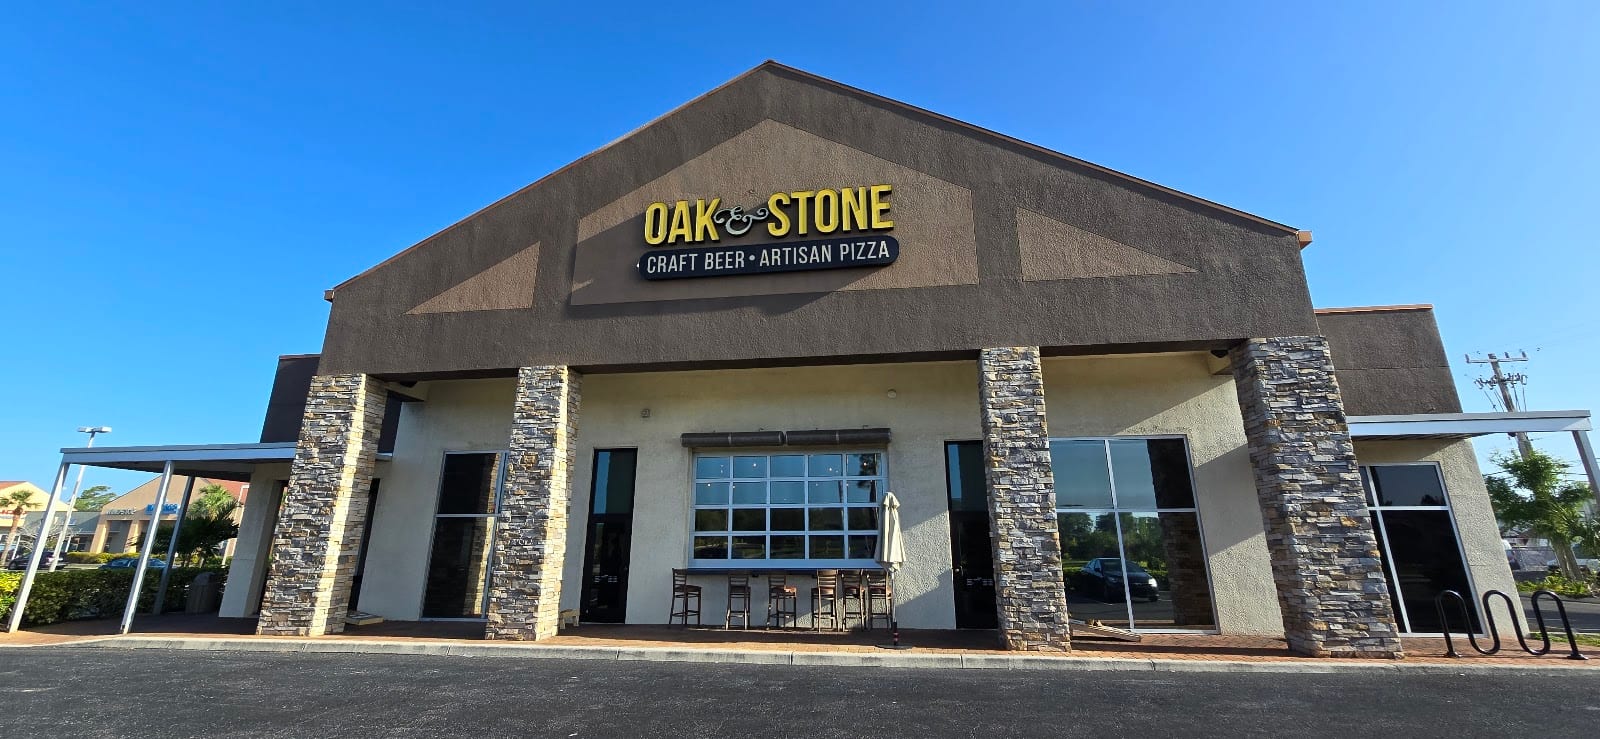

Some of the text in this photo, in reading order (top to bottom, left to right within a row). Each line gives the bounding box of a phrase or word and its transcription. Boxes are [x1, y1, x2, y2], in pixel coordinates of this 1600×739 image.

[644, 184, 894, 246] OAK & STONE
[646, 240, 890, 274] CRAFT BEER ARTISAN PIZZA
